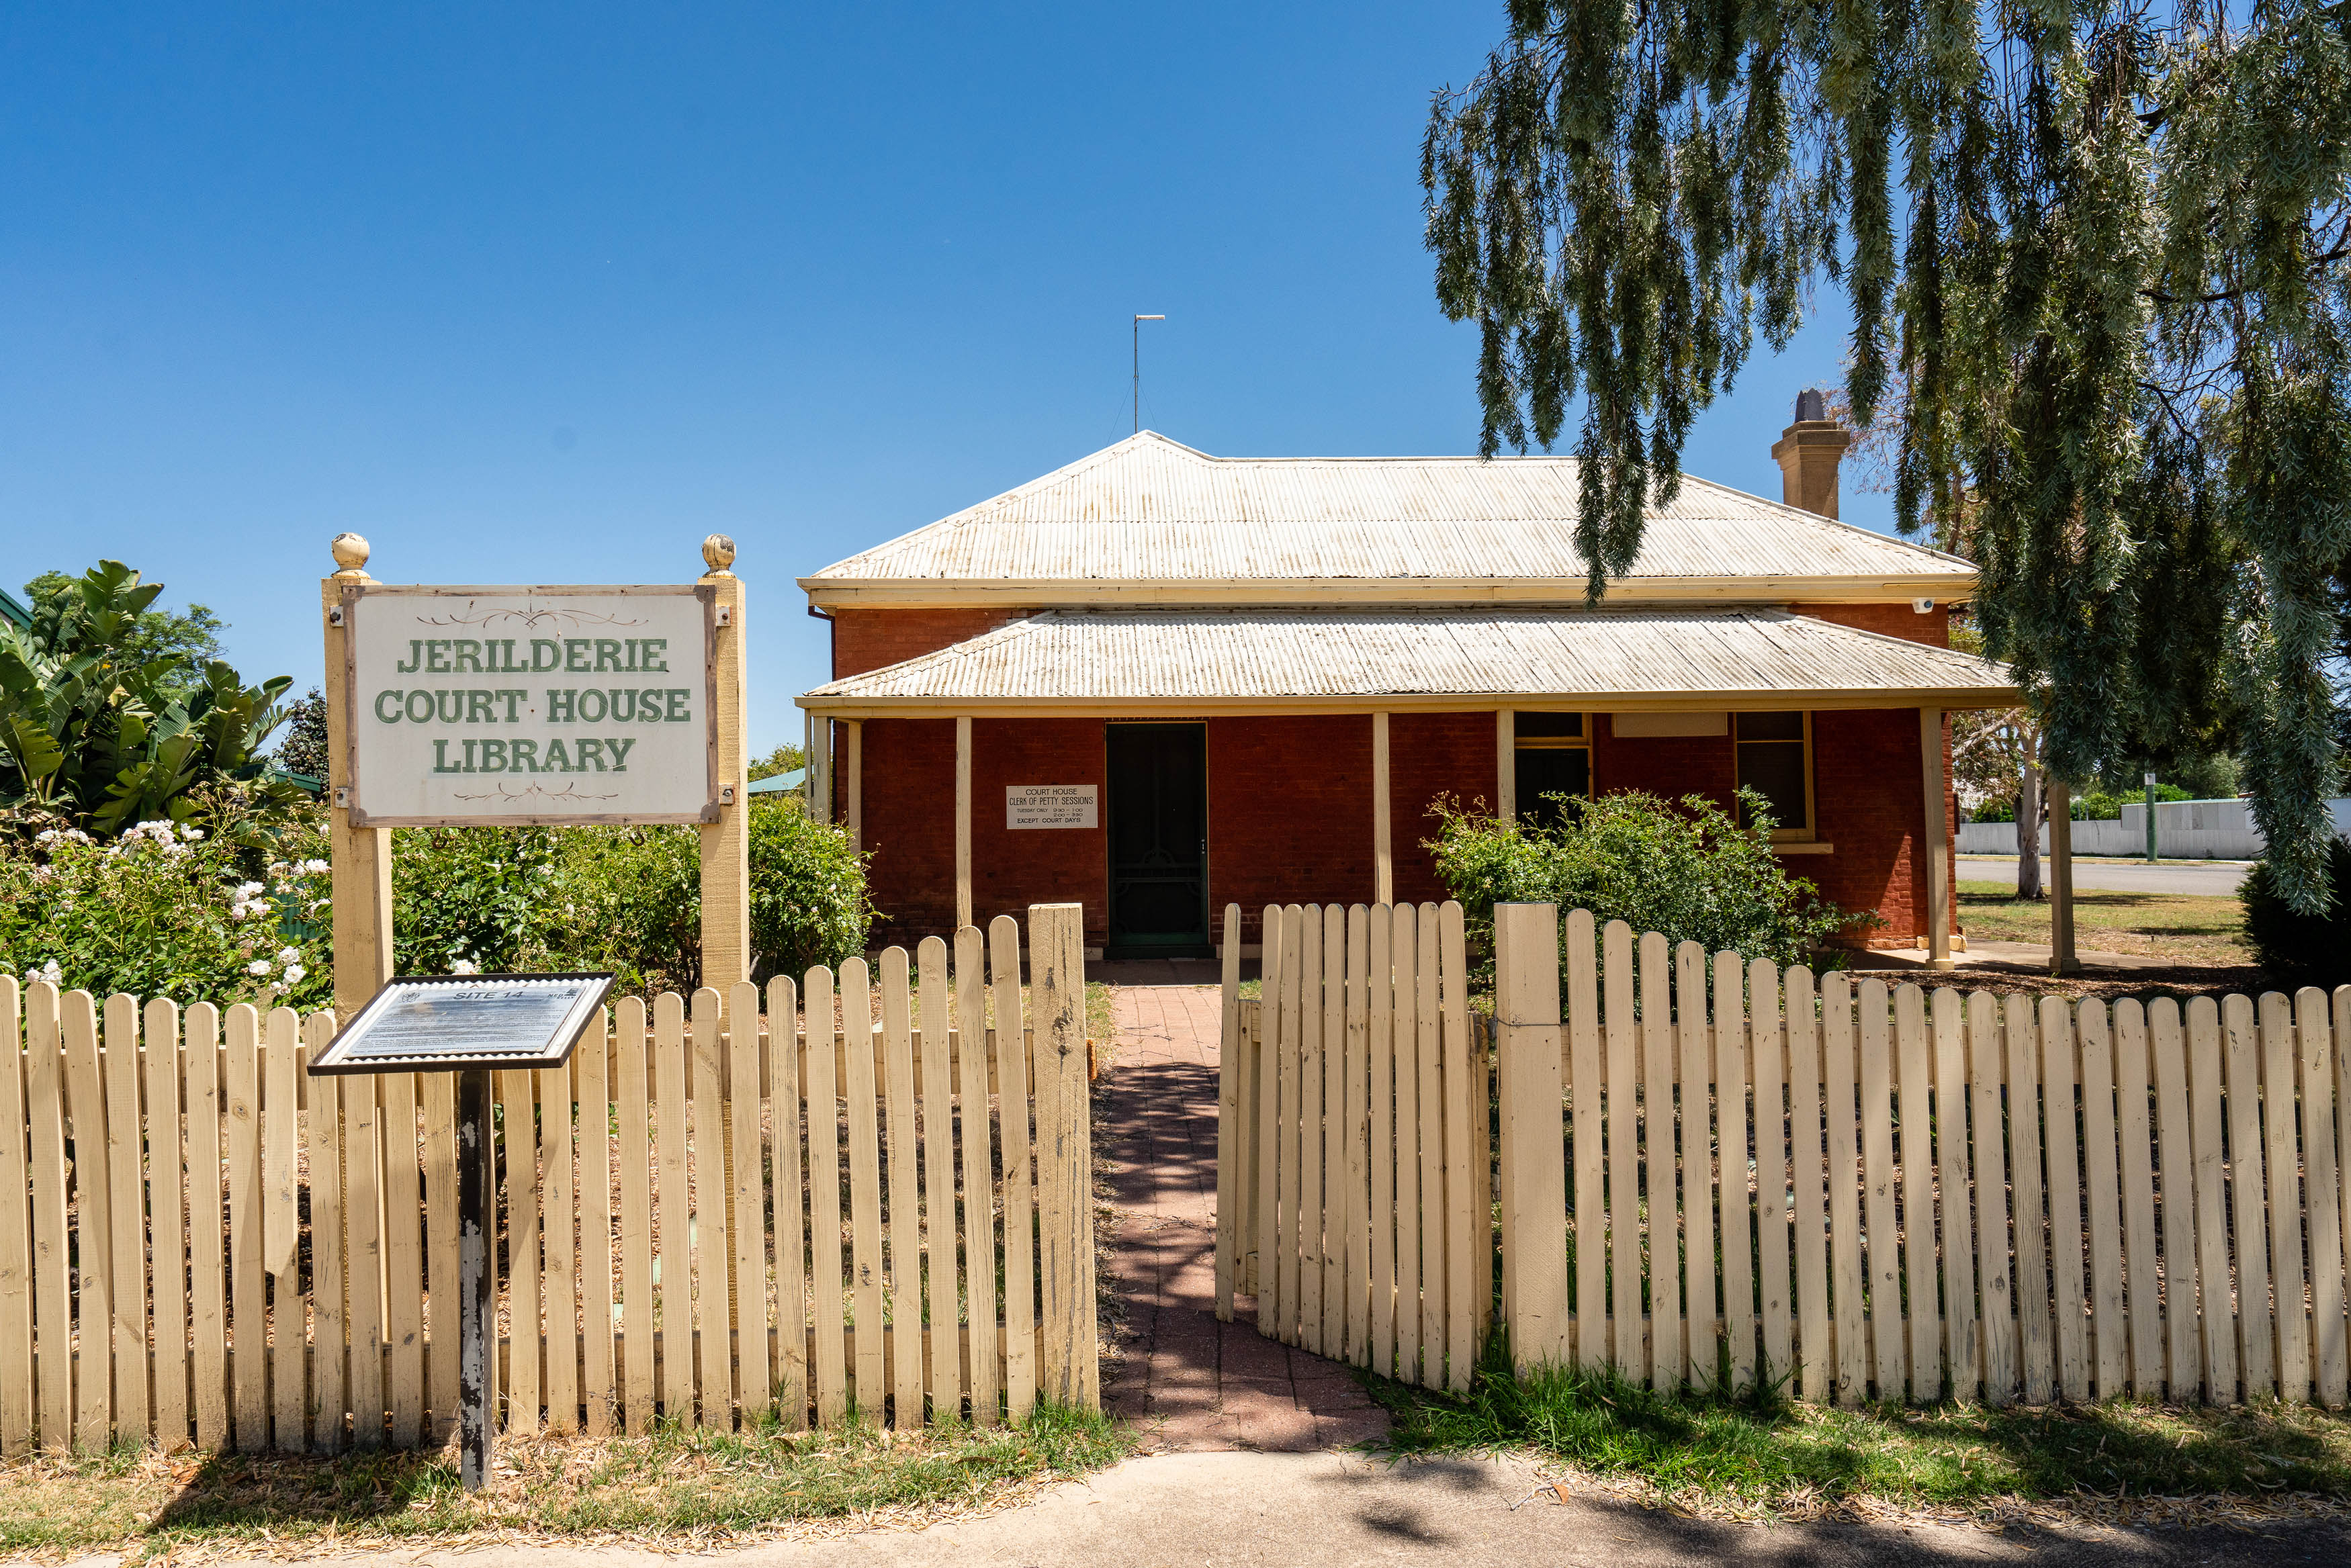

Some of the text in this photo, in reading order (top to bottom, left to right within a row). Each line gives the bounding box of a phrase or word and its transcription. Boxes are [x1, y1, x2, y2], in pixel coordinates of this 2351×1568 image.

[397, 638, 668, 674] JERILDERIE
[374, 688, 691, 724] COURT HOUSE
[432, 737, 636, 774] LIBRARY
[1009, 796, 1094, 806] CLERK OF PETTY SESSIONS
[453, 992, 498, 1000] SITE
